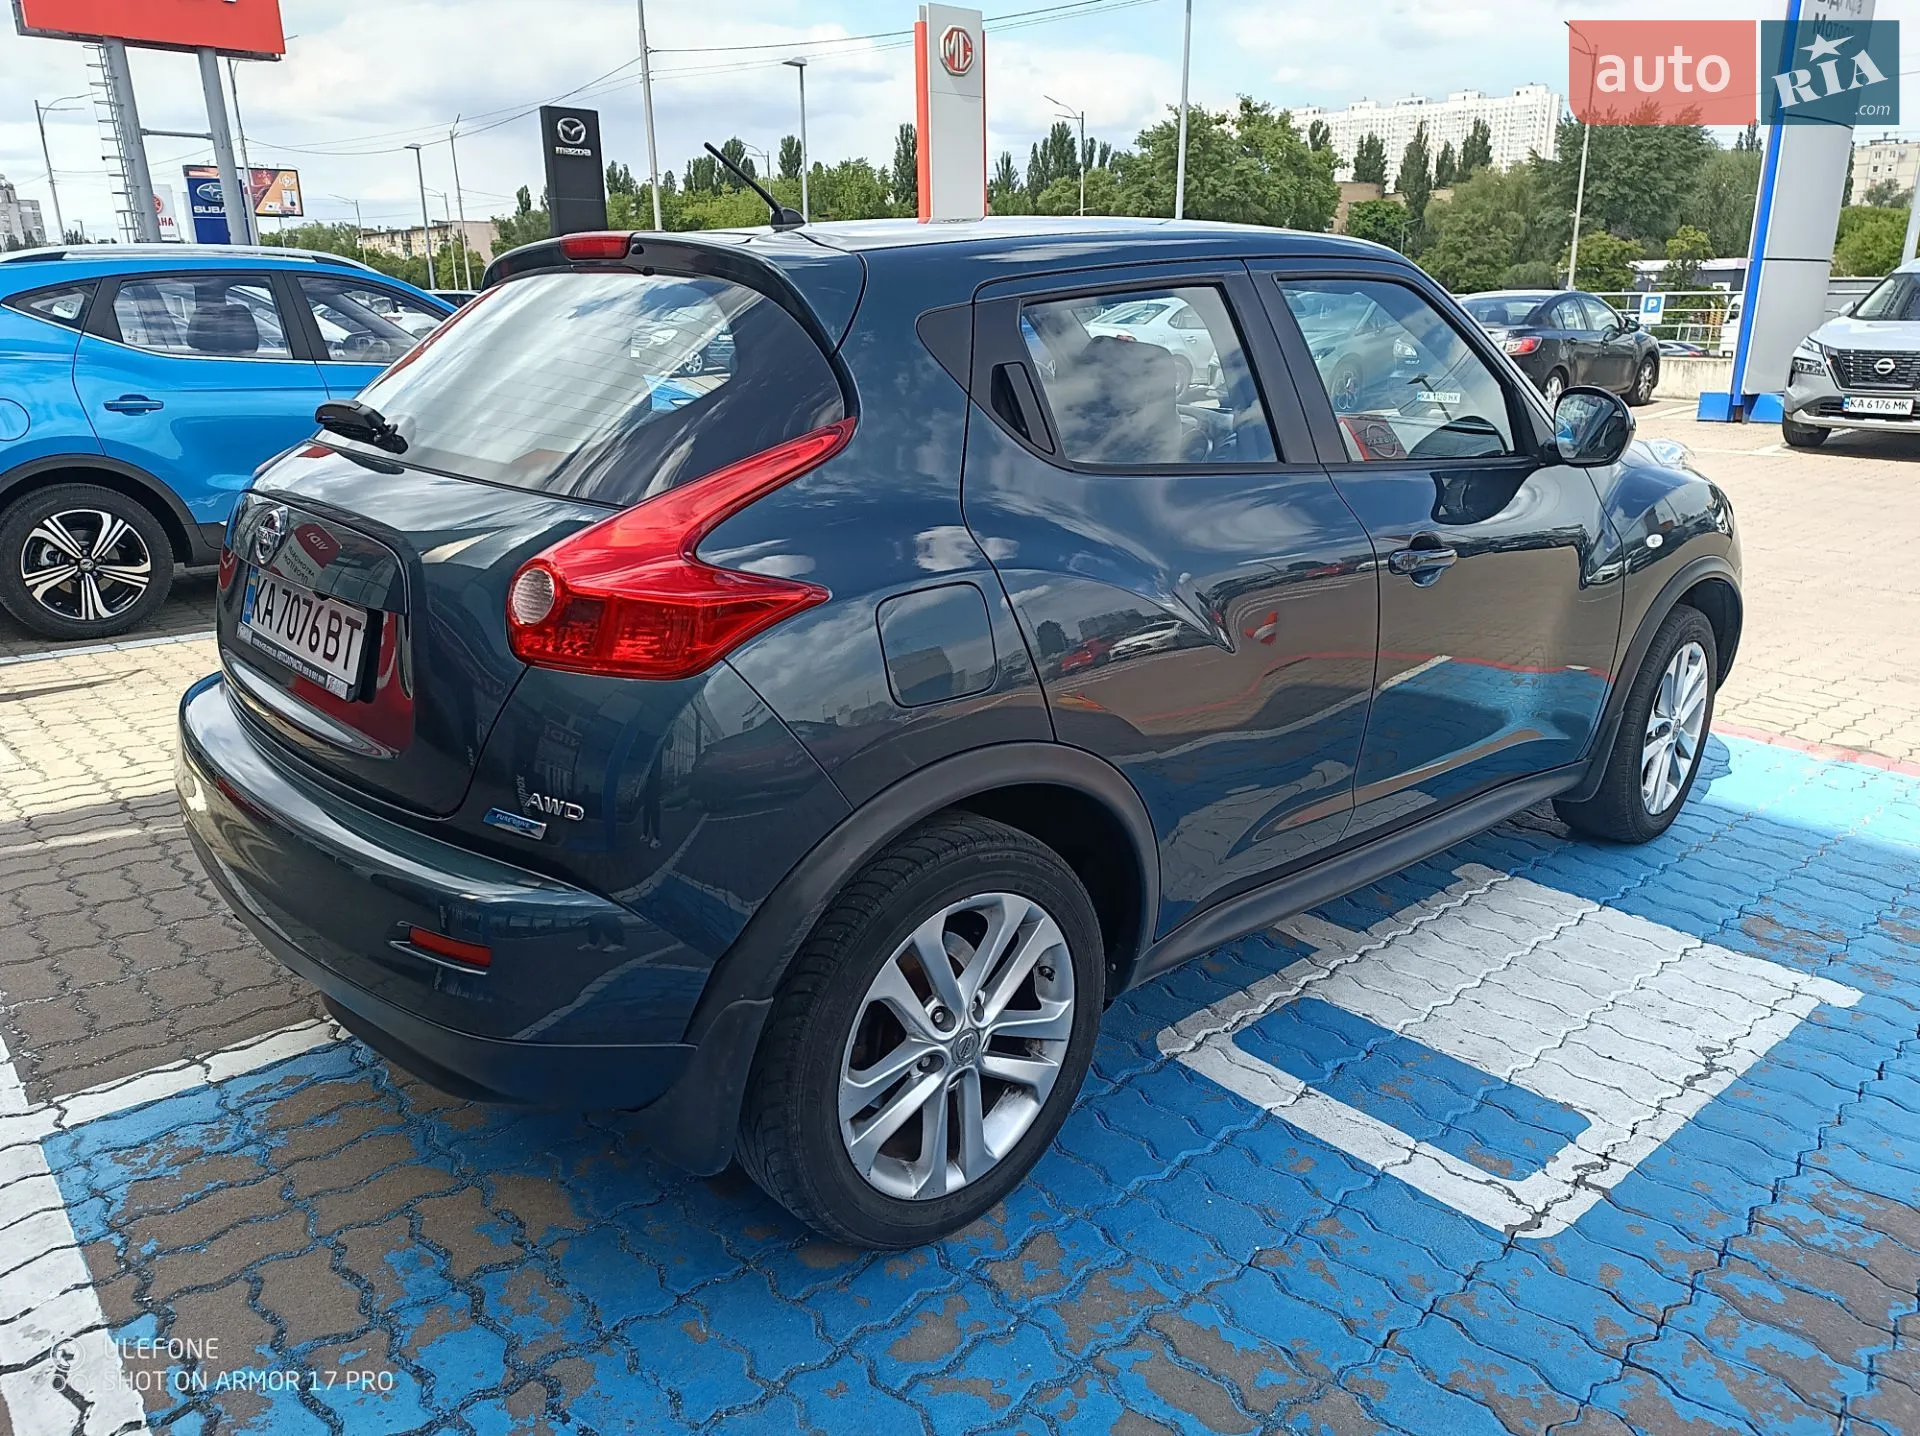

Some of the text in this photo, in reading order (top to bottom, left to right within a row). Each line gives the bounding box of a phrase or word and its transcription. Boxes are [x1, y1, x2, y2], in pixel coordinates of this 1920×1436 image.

[945, 30, 972, 70] MG
[193, 205, 226, 214] SUBA
[526, 793, 585, 821] AWD
